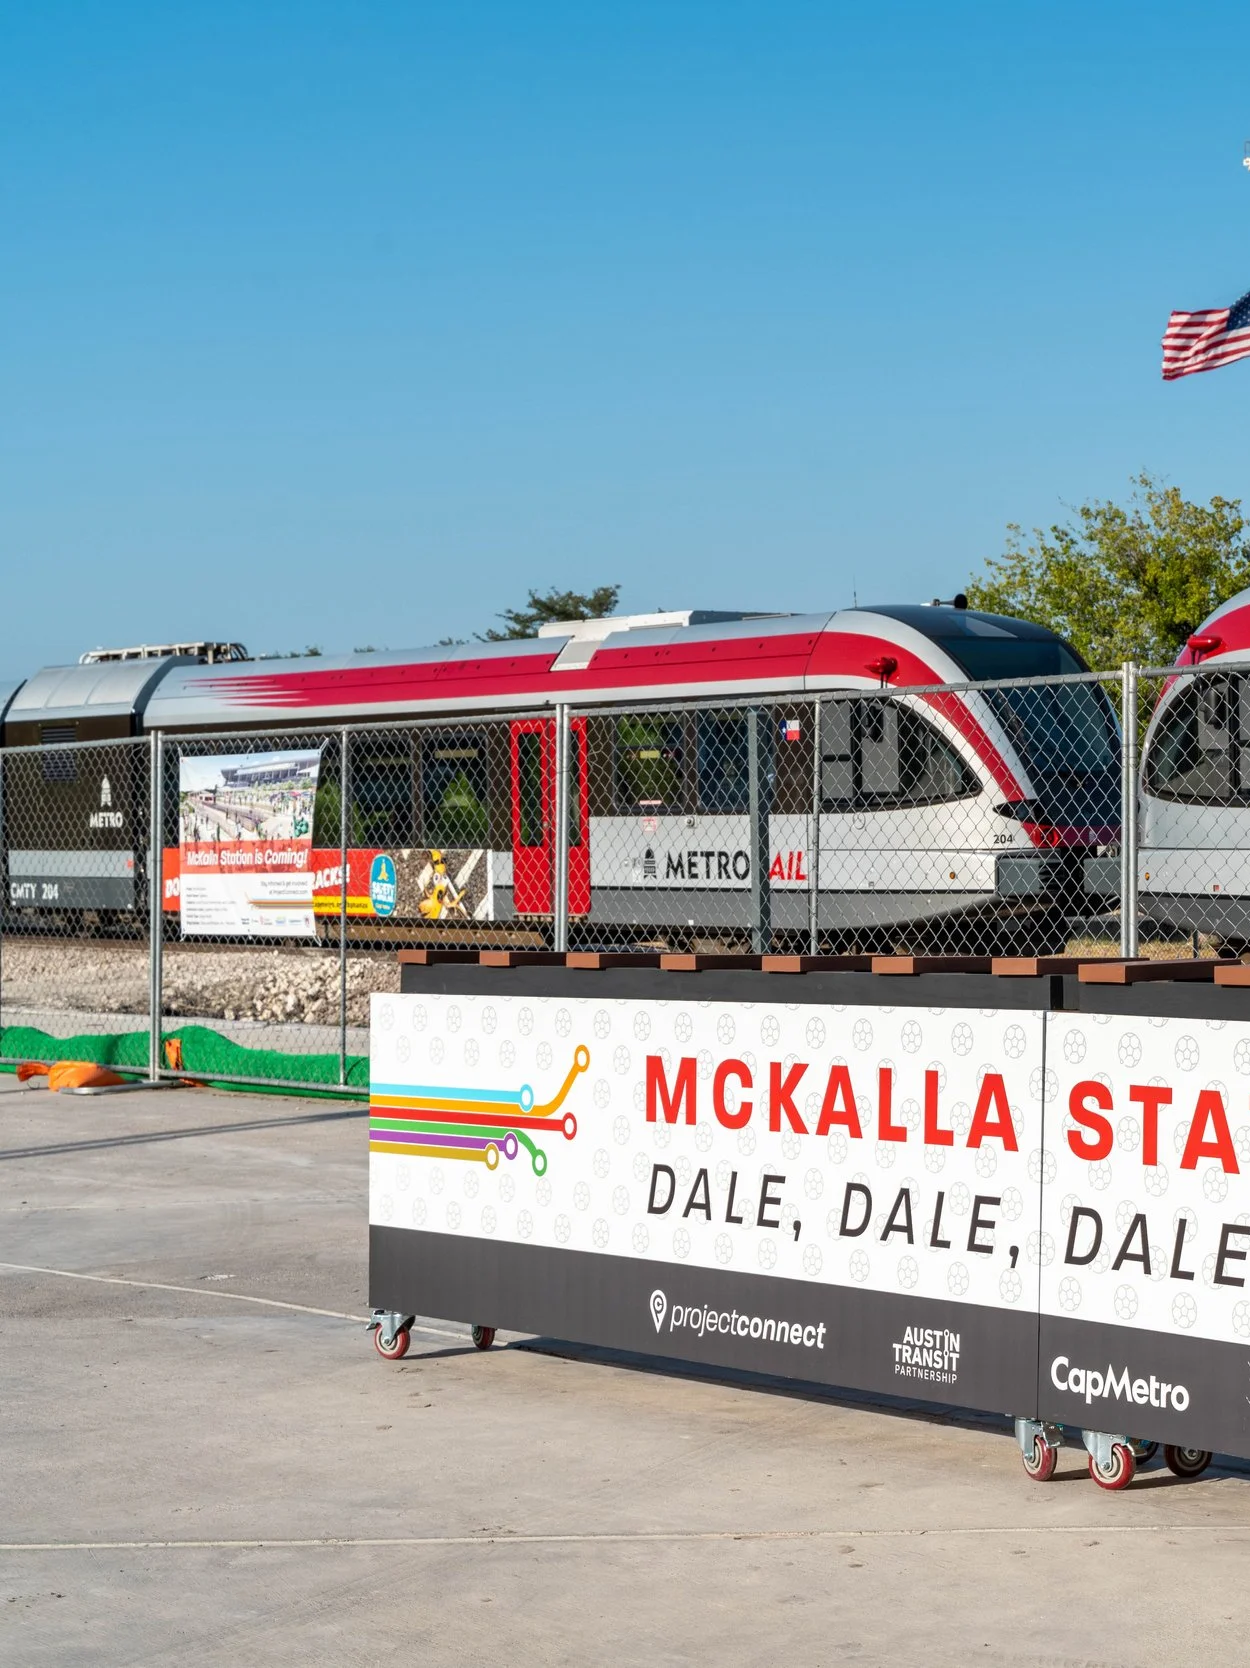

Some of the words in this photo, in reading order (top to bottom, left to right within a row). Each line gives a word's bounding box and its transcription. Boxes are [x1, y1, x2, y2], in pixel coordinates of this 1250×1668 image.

[90, 812, 123, 828] METRO
[994, 834, 1013, 844] 204
[220, 849, 253, 866] Station
[254, 849, 263, 865] is
[264, 848, 308, 868] Coming!
[666, 850, 807, 881] METROAIL
[10, 882, 37, 899] CMTY
[42, 883, 59, 900] 204
[646, 1055, 1019, 1152] MCKALLA
[647, 1163, 801, 1242] DALE,
[839, 1181, 1019, 1269] DALE,
[903, 1326, 960, 1352] AUSTIN
[892, 1343, 960, 1371] TRANSIT
[895, 1364, 957, 1384] PARTNERSHIP
[1051, 1356, 1189, 1411] CapMetro
